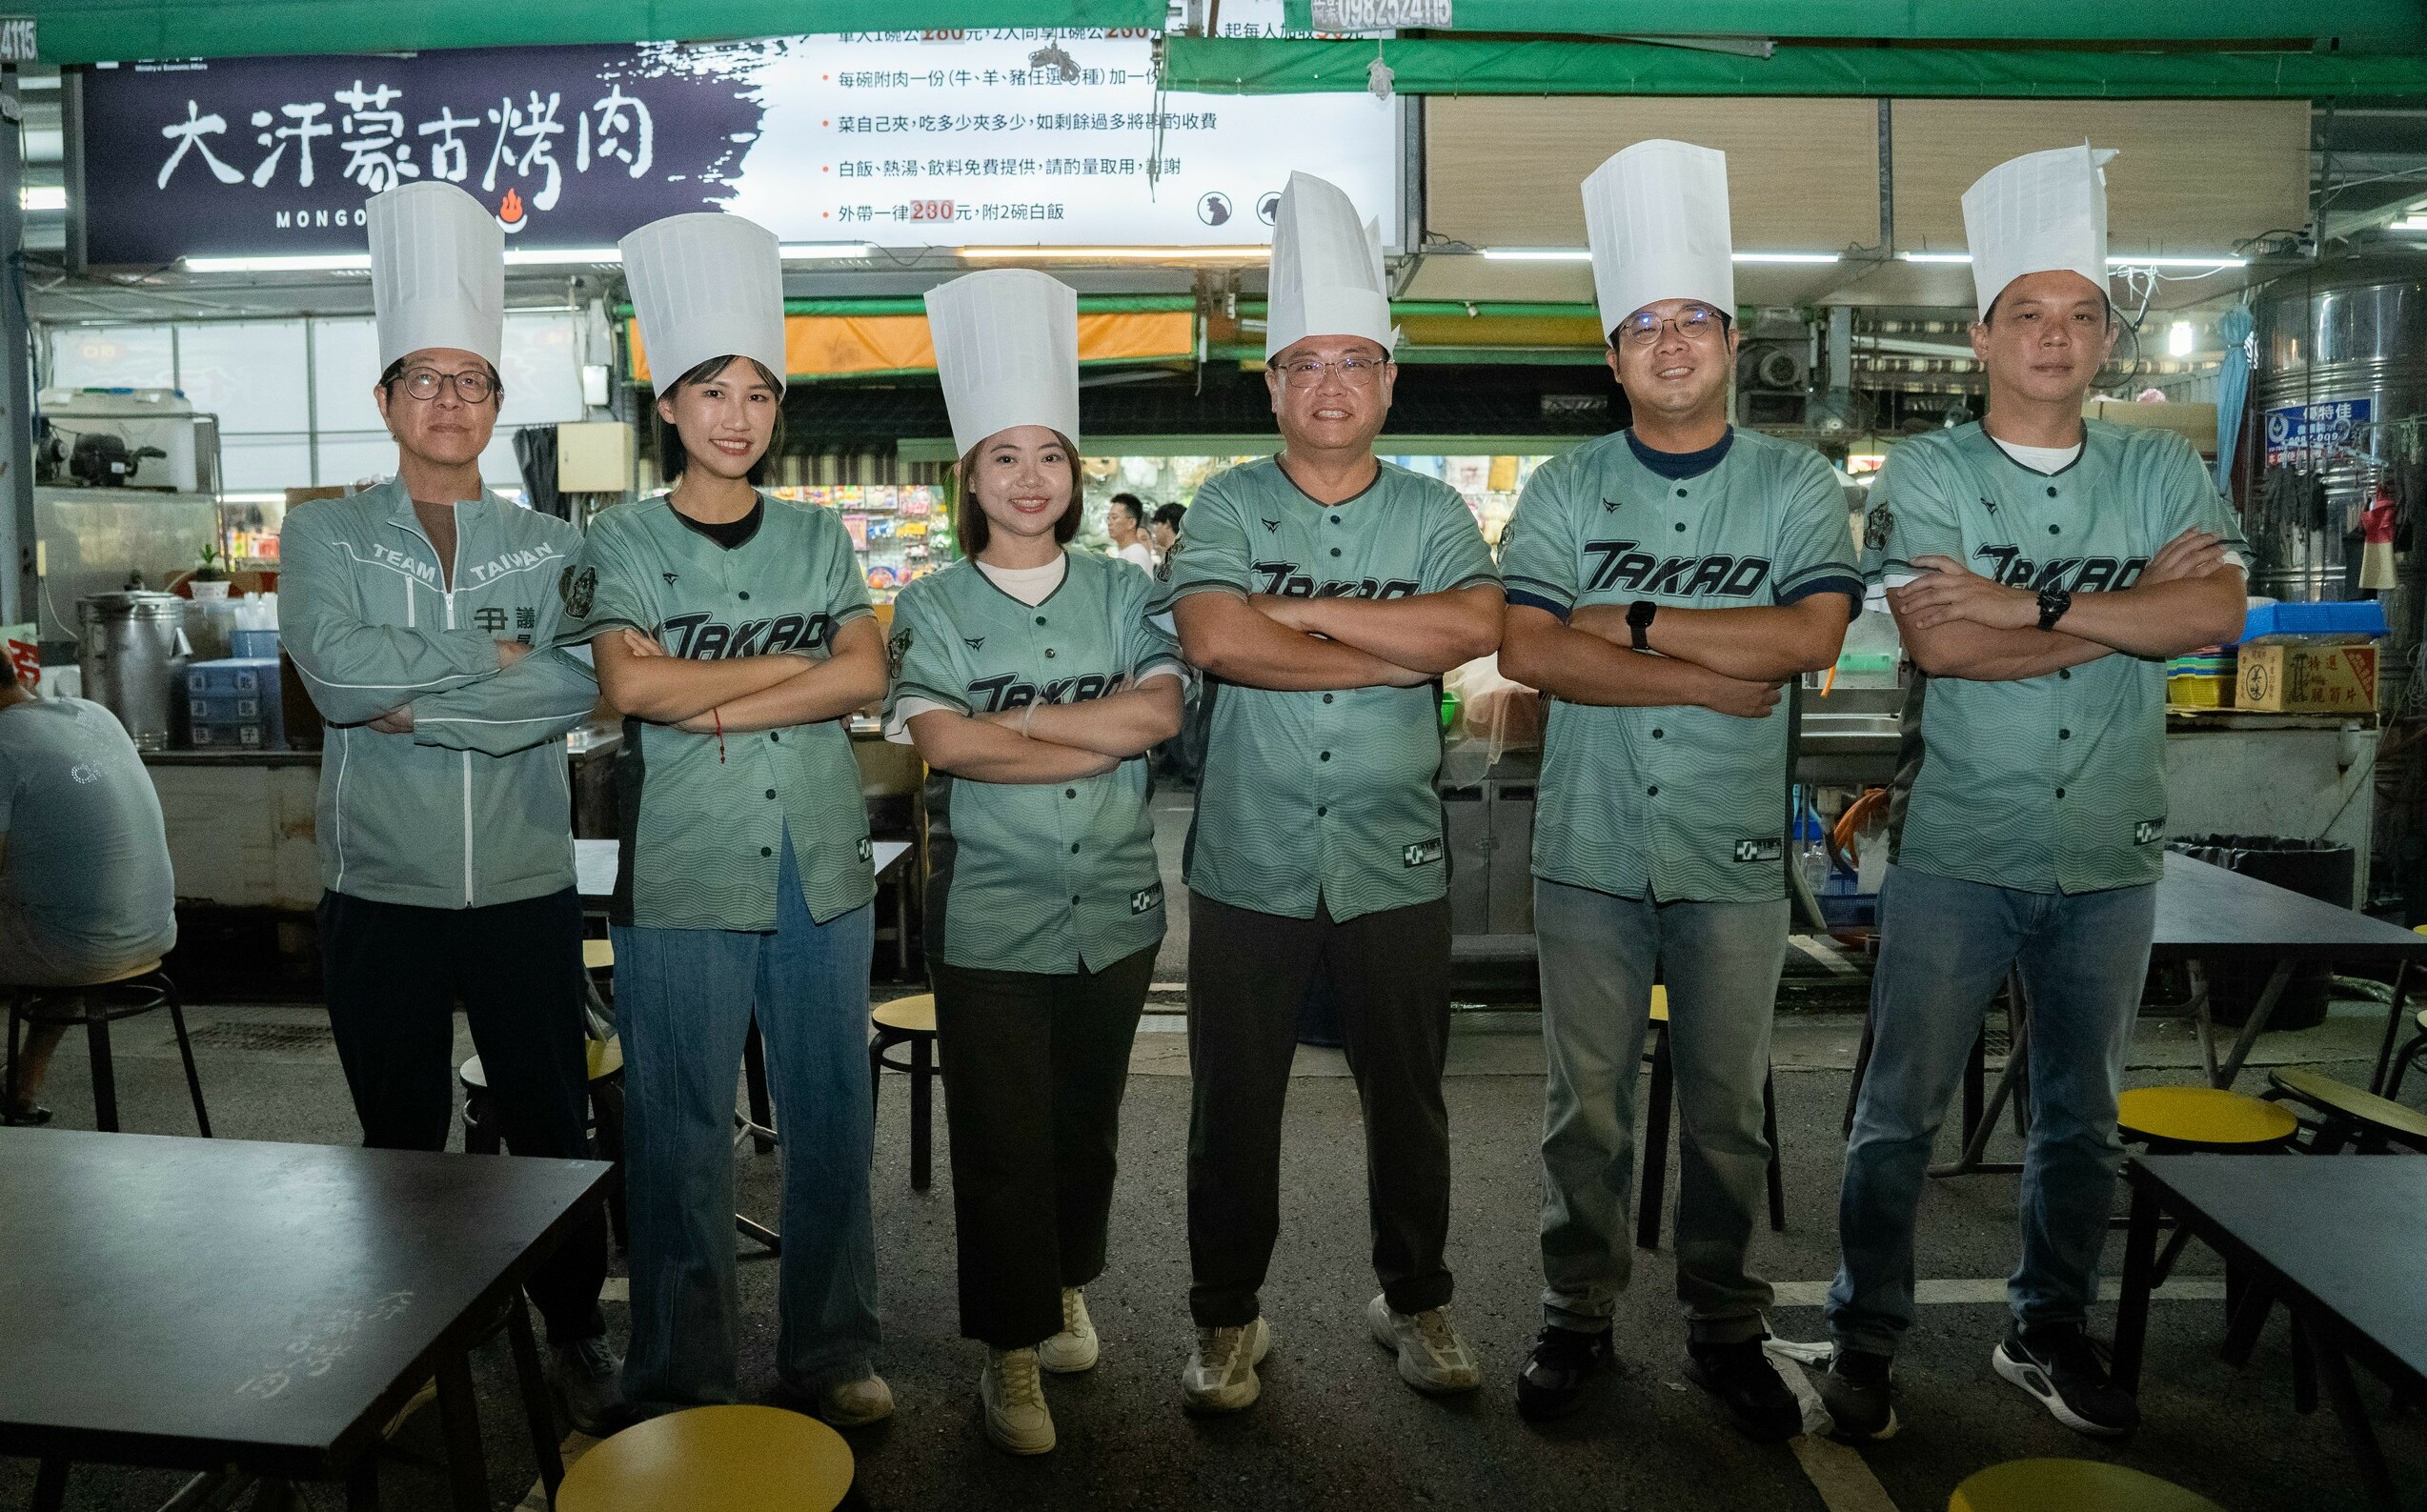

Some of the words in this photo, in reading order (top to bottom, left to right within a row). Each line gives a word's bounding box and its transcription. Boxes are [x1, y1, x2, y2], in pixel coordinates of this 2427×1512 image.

[157, 79, 654, 212] 大汗蒙古烤肉
[373, 543, 435, 583] TEAM
[470, 541, 554, 581] TAIWAN
[1583, 539, 1771, 598] TAKAO
